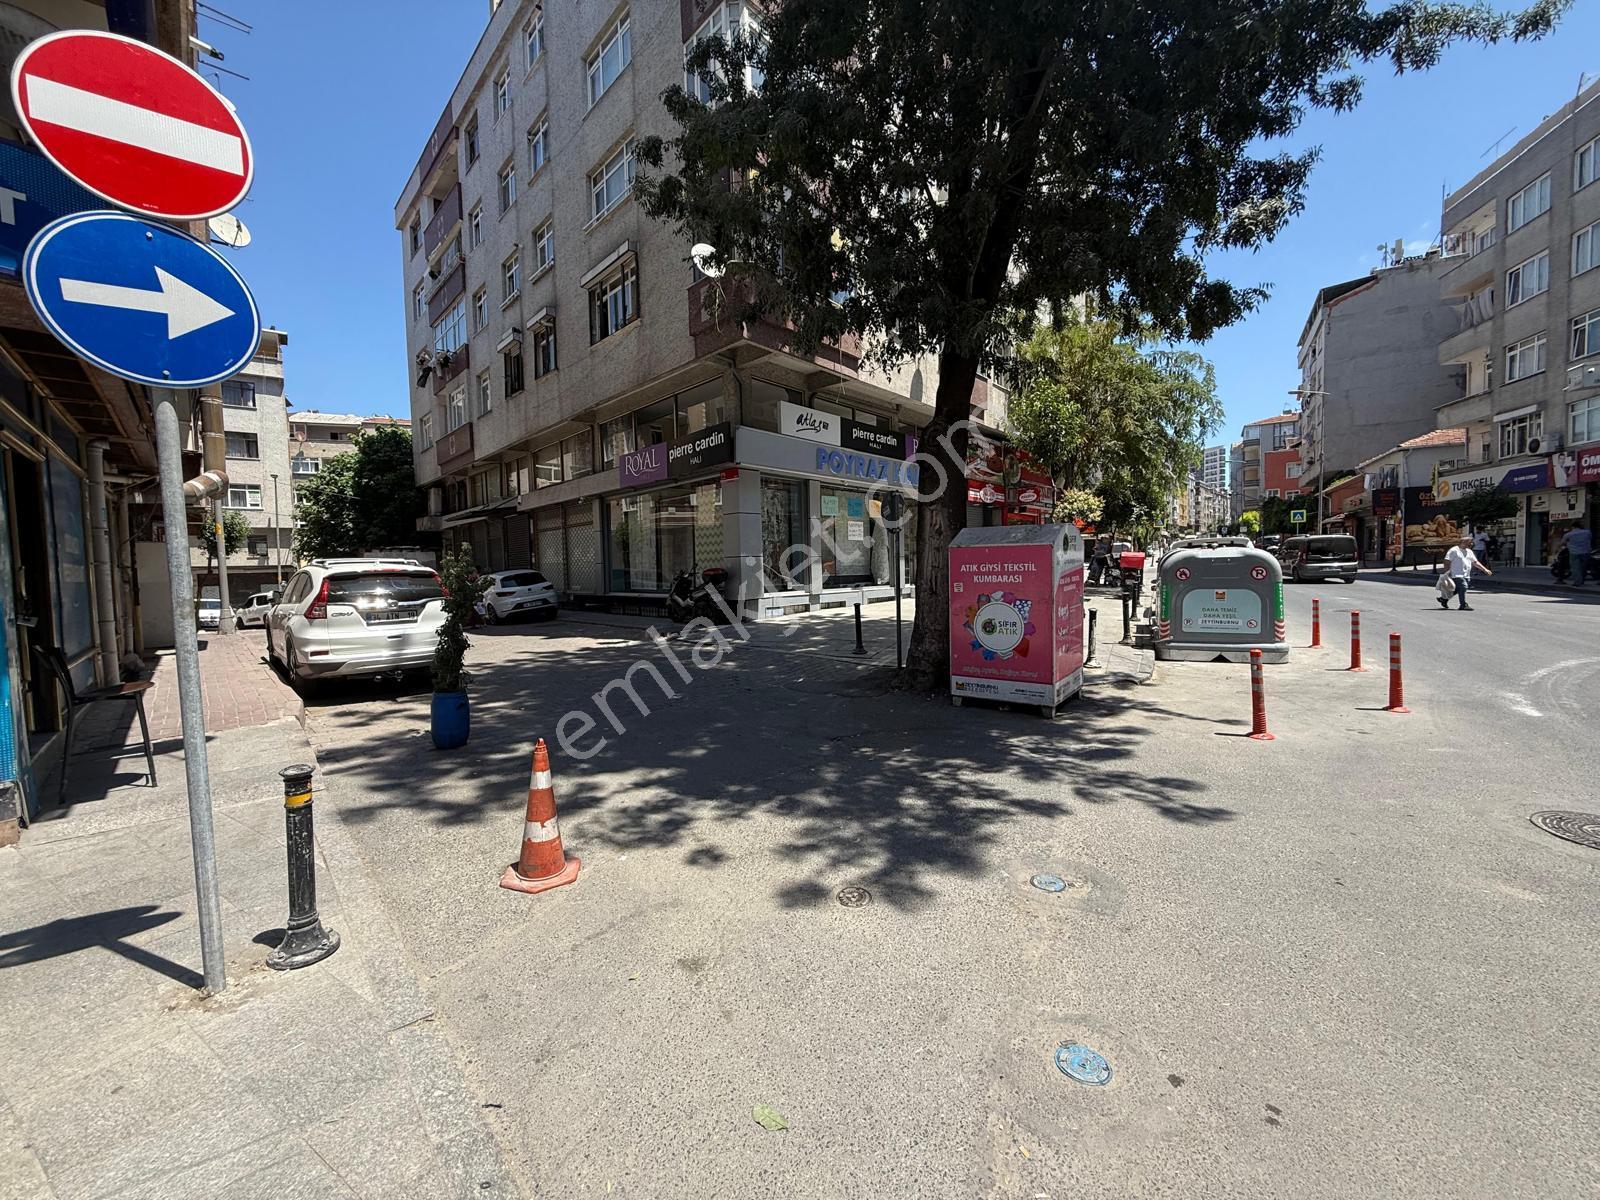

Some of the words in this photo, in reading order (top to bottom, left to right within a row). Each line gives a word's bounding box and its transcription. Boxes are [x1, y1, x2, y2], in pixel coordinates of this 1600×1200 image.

[796, 412, 822, 433] atlas
[669, 442, 693, 463] pierre
[695, 431, 724, 454] cardin
[852, 427, 875, 442] pierre
[876, 433, 898, 447] cardin
[625, 449, 660, 476] ROYAL
[816, 447, 889, 481] POYRAZ
[1452, 476, 1495, 492] TURKCELL
[960, 564, 978, 572] ATIK
[980, 562, 1001, 572] GİYSİ
[1004, 562, 1037, 572] TEKSTİL
[973, 575, 1022, 583] KUMBARASI
